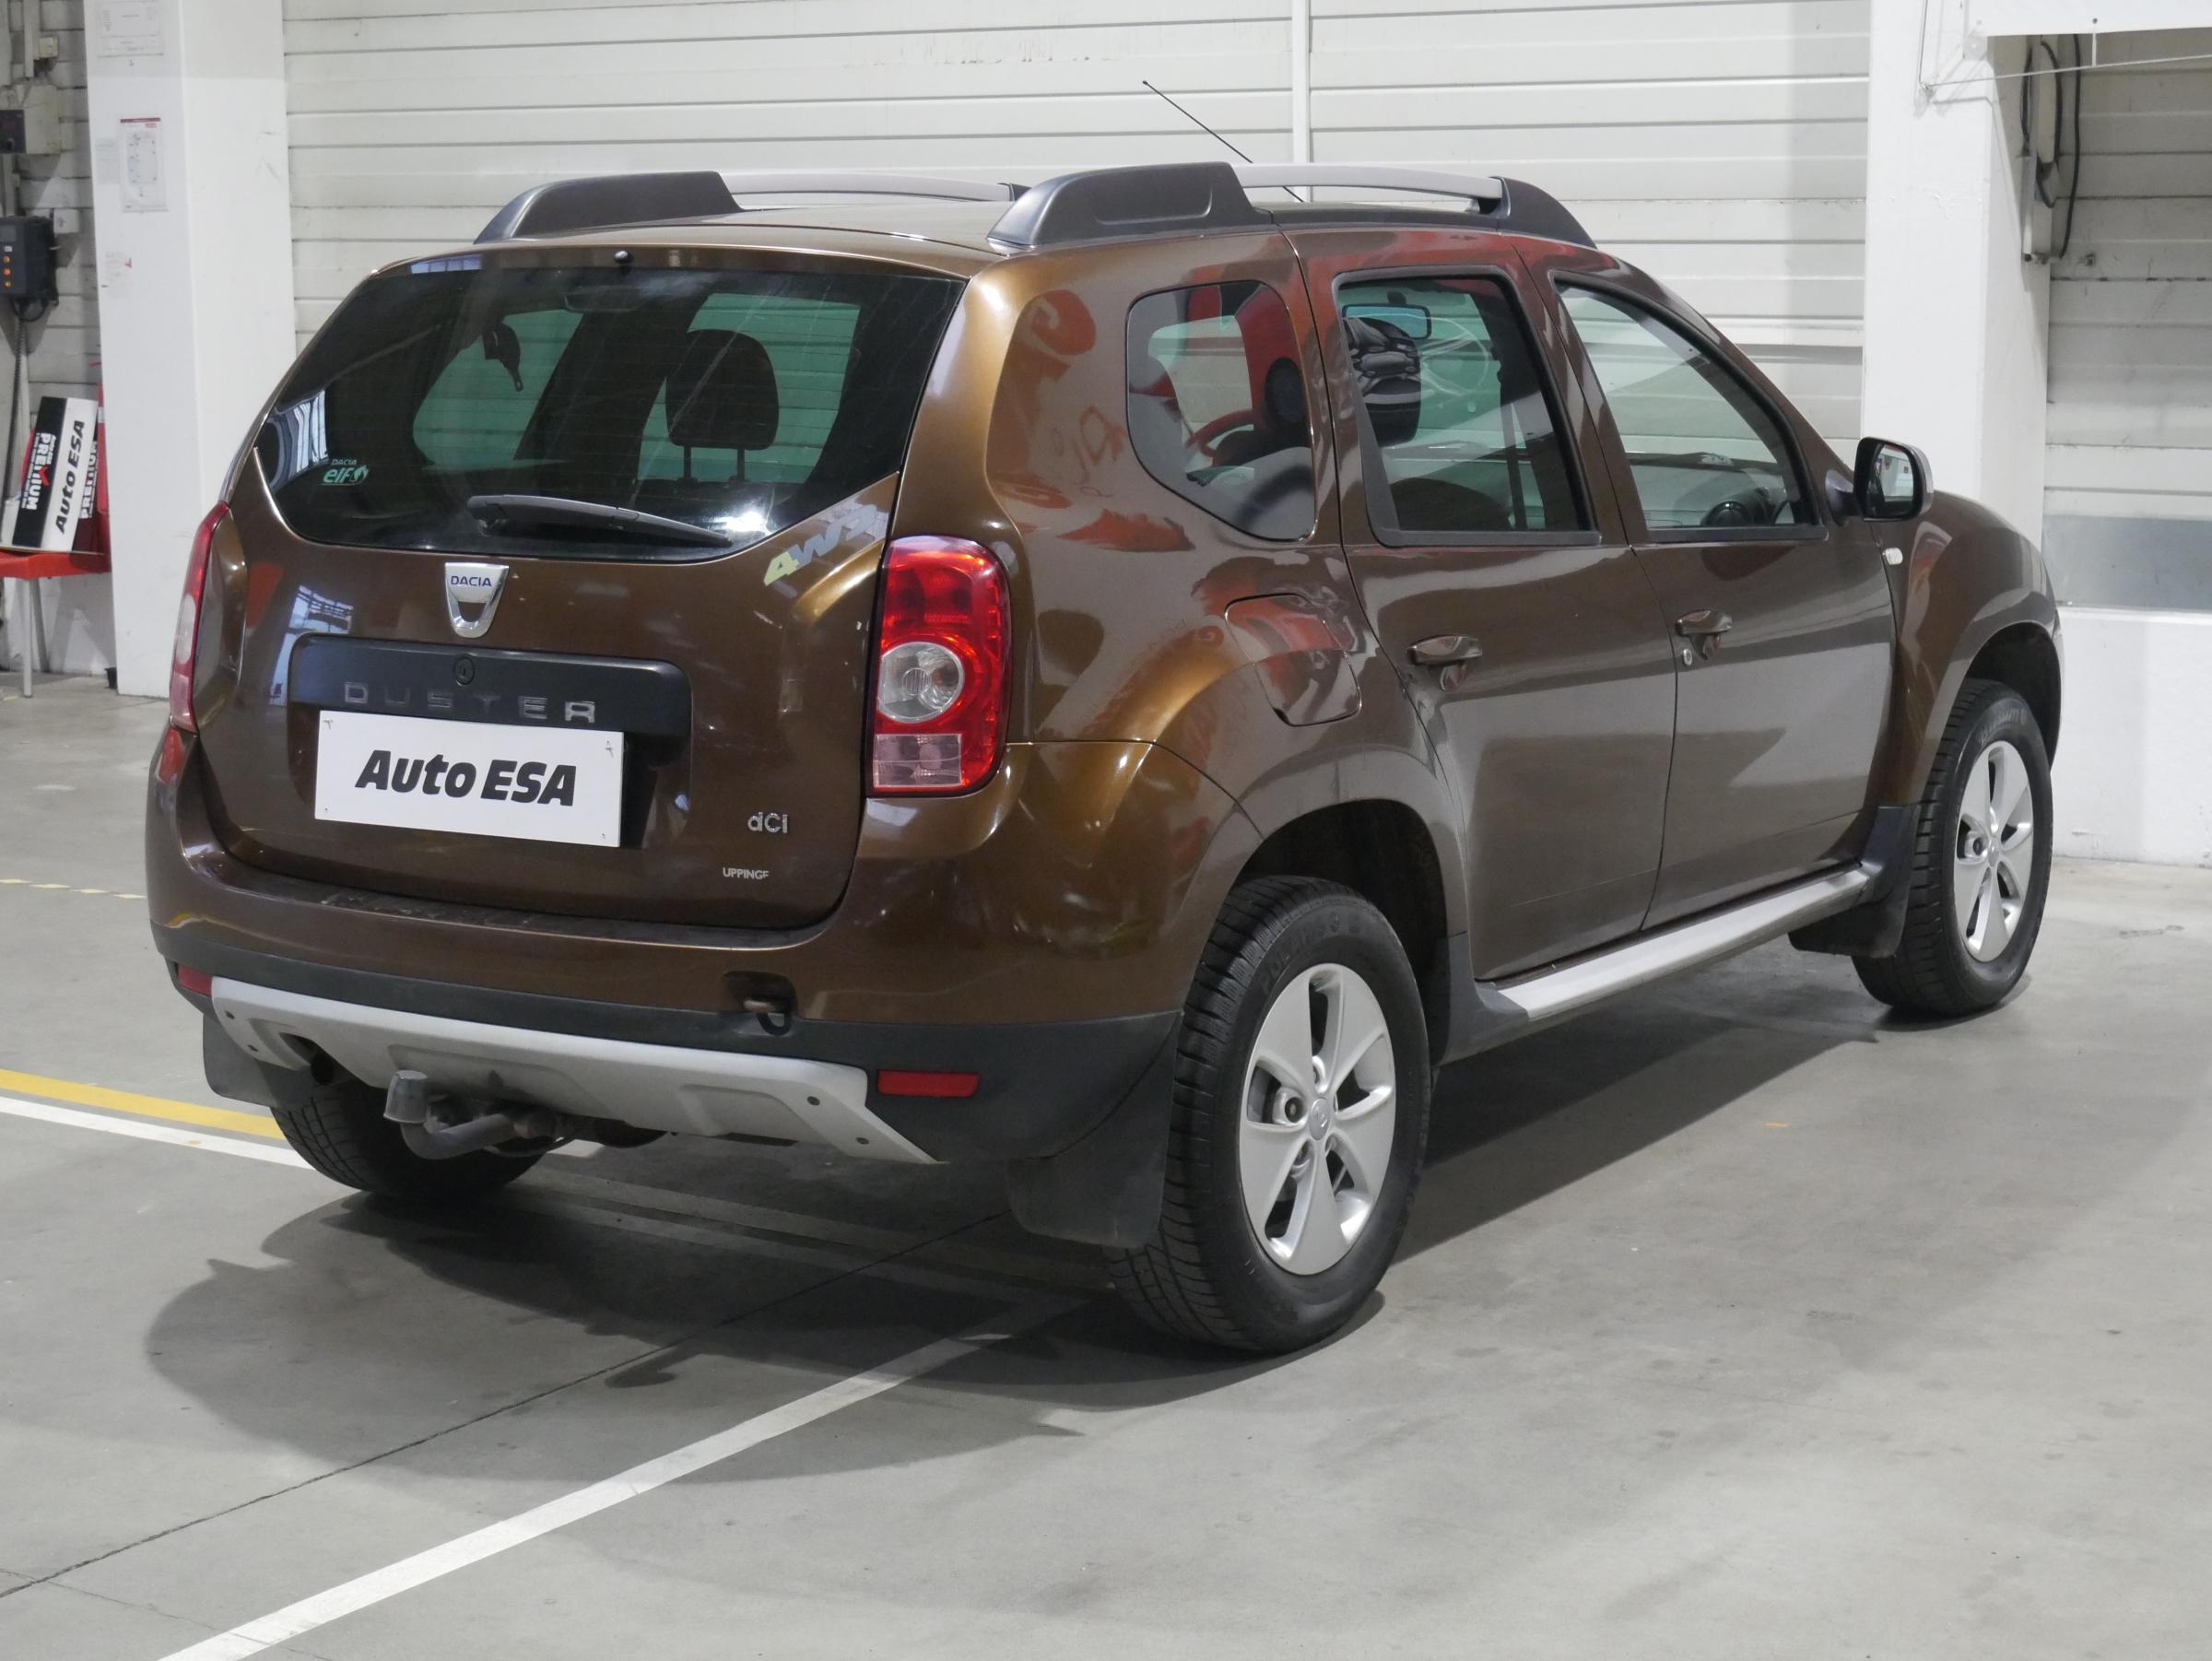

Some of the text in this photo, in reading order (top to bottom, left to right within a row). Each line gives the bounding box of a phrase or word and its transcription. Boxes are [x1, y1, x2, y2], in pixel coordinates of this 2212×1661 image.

[26, 433, 52, 510] PREMIUM
[55, 420, 85, 535] Auto ESA
[324, 467, 354, 483] elf
[451, 575, 492, 587] DACIA
[345, 682, 595, 723] DUSTER
[355, 749, 577, 807] Auto ESA
